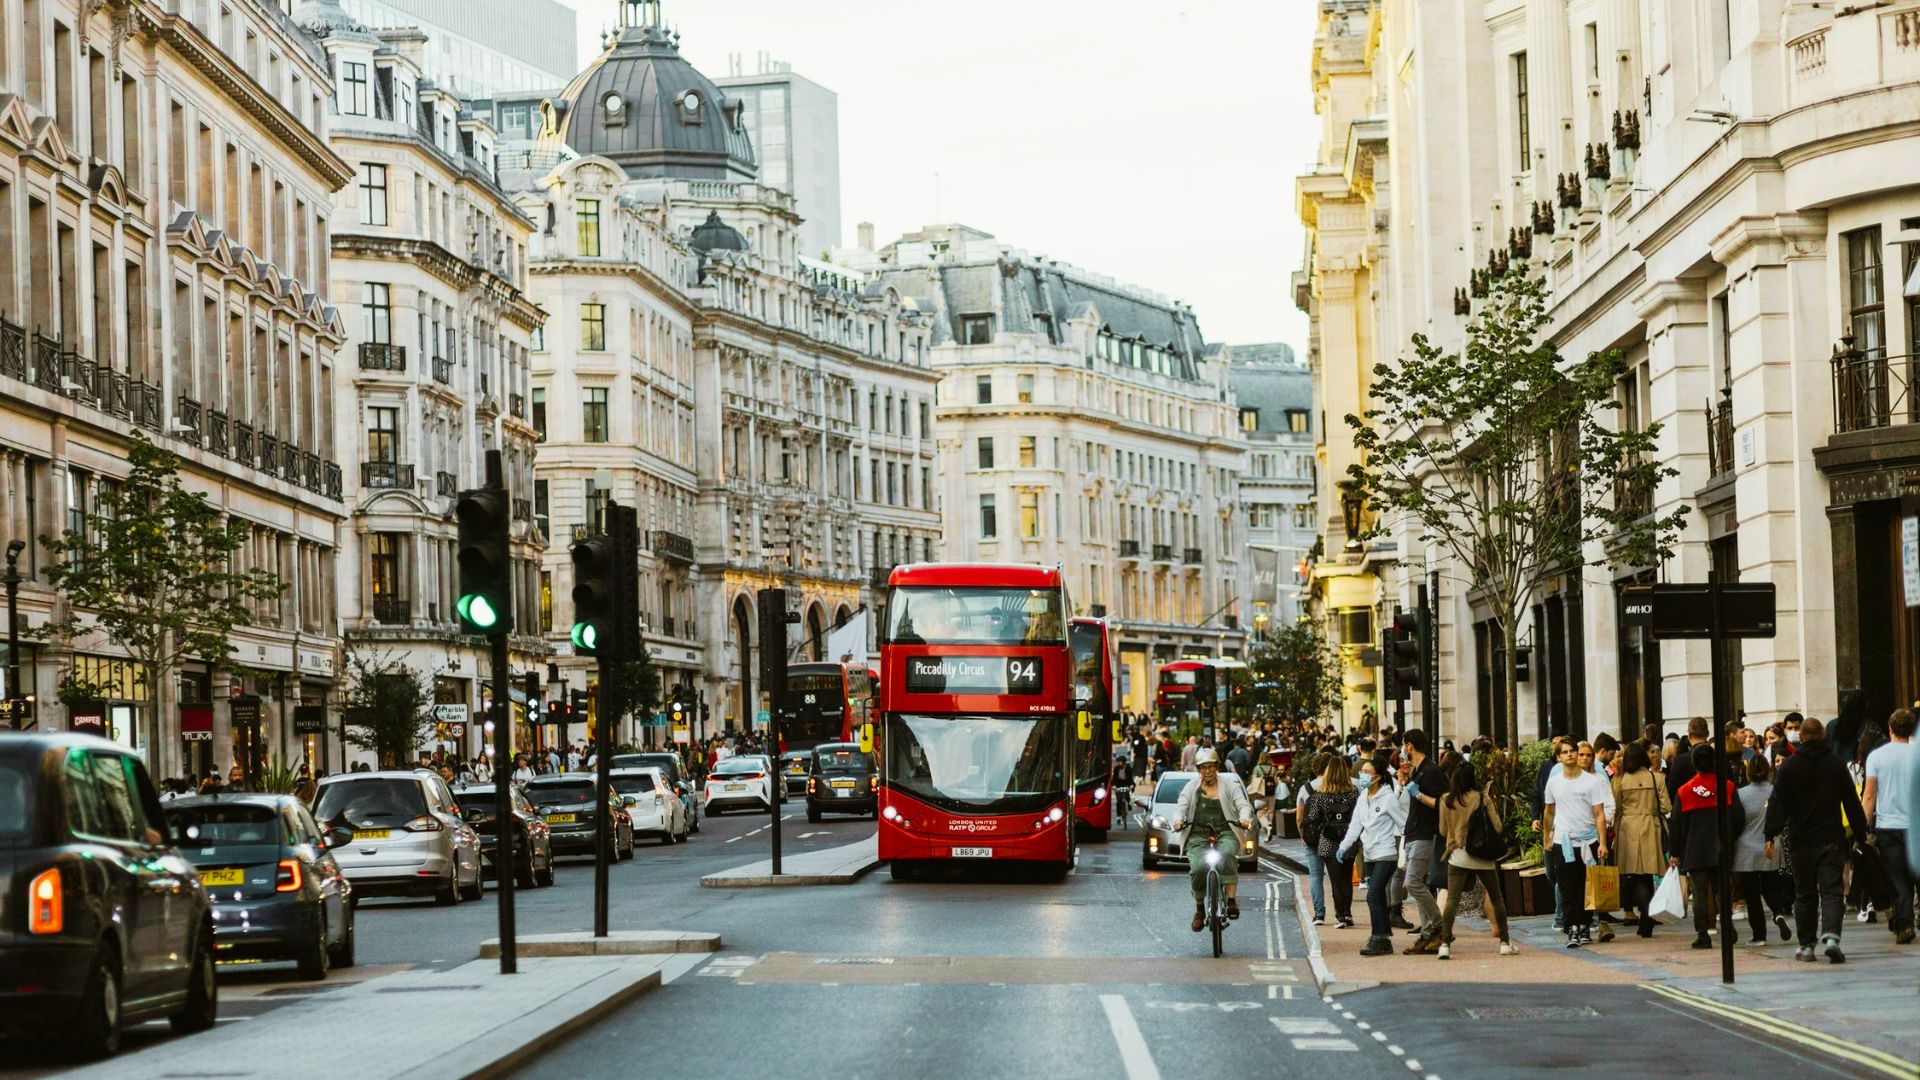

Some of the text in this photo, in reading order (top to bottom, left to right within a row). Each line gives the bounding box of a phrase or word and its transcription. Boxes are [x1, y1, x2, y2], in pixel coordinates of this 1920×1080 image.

[915, 661, 985, 678] Piccadilly Circus
[1009, 660, 1036, 682] 94
[804, 694, 816, 704] 88
[442, 705, 465, 713] Marble
[74, 715, 101, 726] CAMPER
[182, 730, 213, 741] TUMI
[955, 848, 990, 856] LB69 JPU
[212, 871, 236, 881] PHZ
